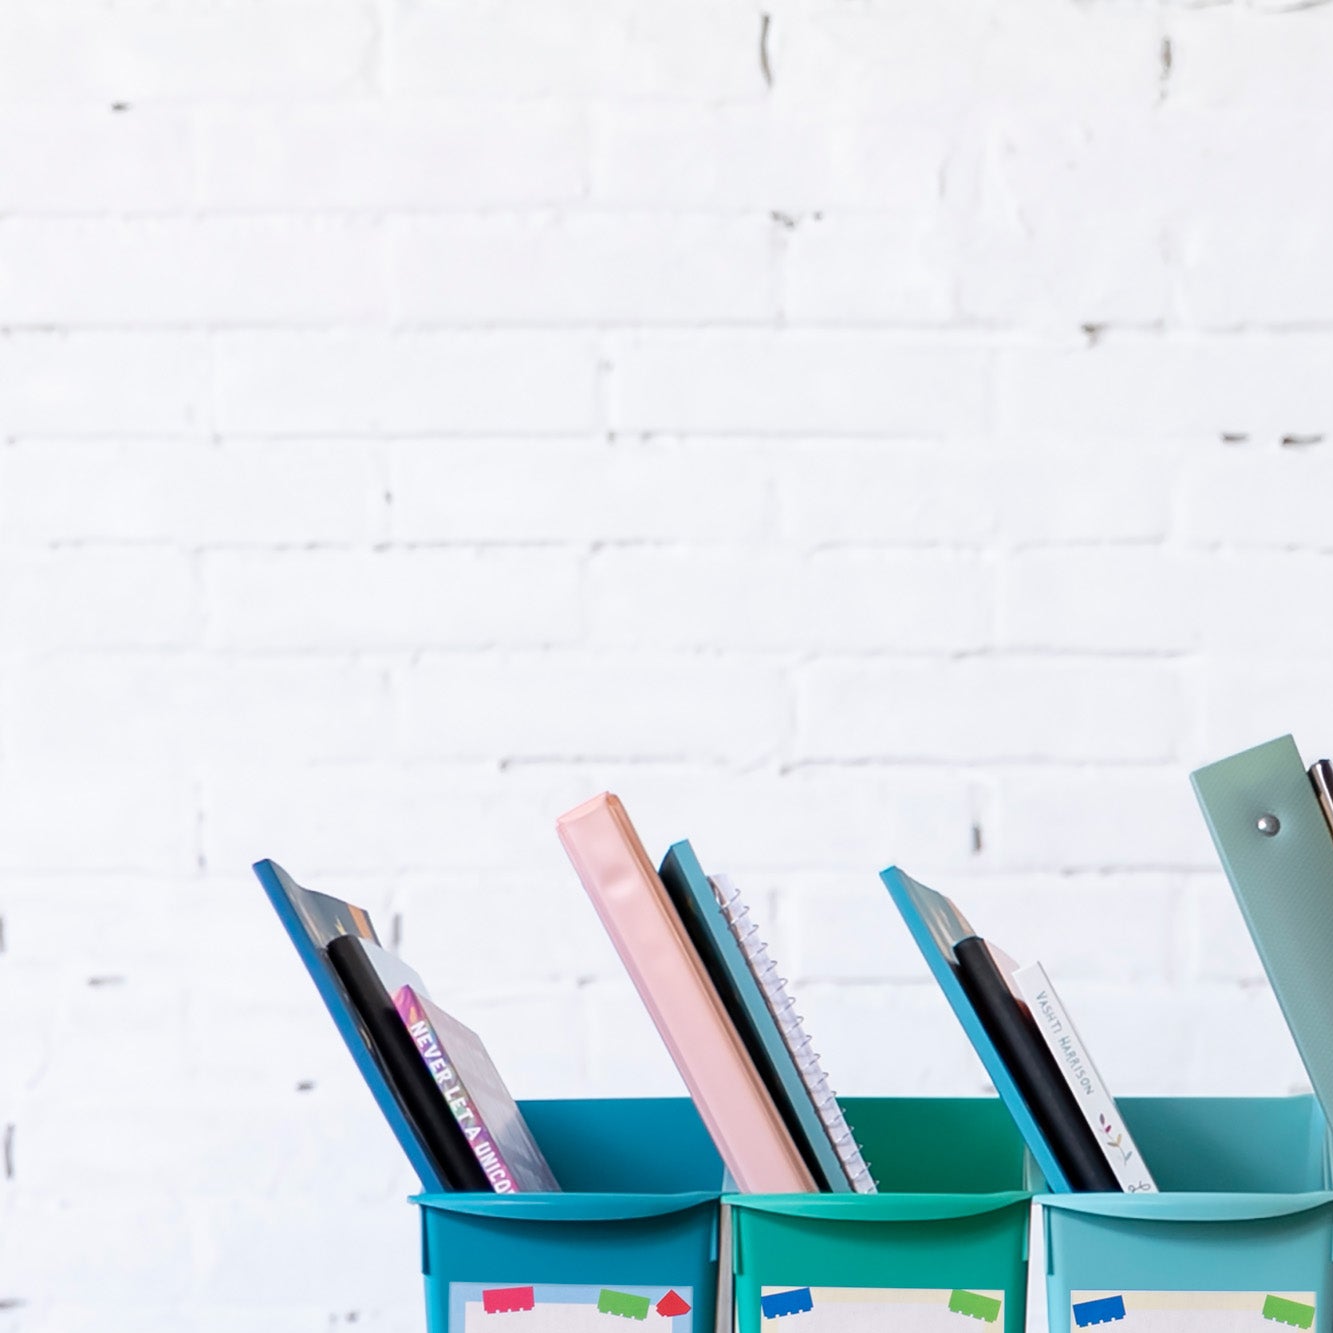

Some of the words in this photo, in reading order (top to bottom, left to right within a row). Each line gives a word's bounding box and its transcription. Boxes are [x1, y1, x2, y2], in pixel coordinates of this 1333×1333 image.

[410, 1020, 453, 1084] NEVER
[444, 1085, 475, 1124] LET
[465, 1126, 482, 1141] A
[1036, 990, 1063, 1035] VASHTI
[1058, 1035, 1095, 1096] HARRISON
